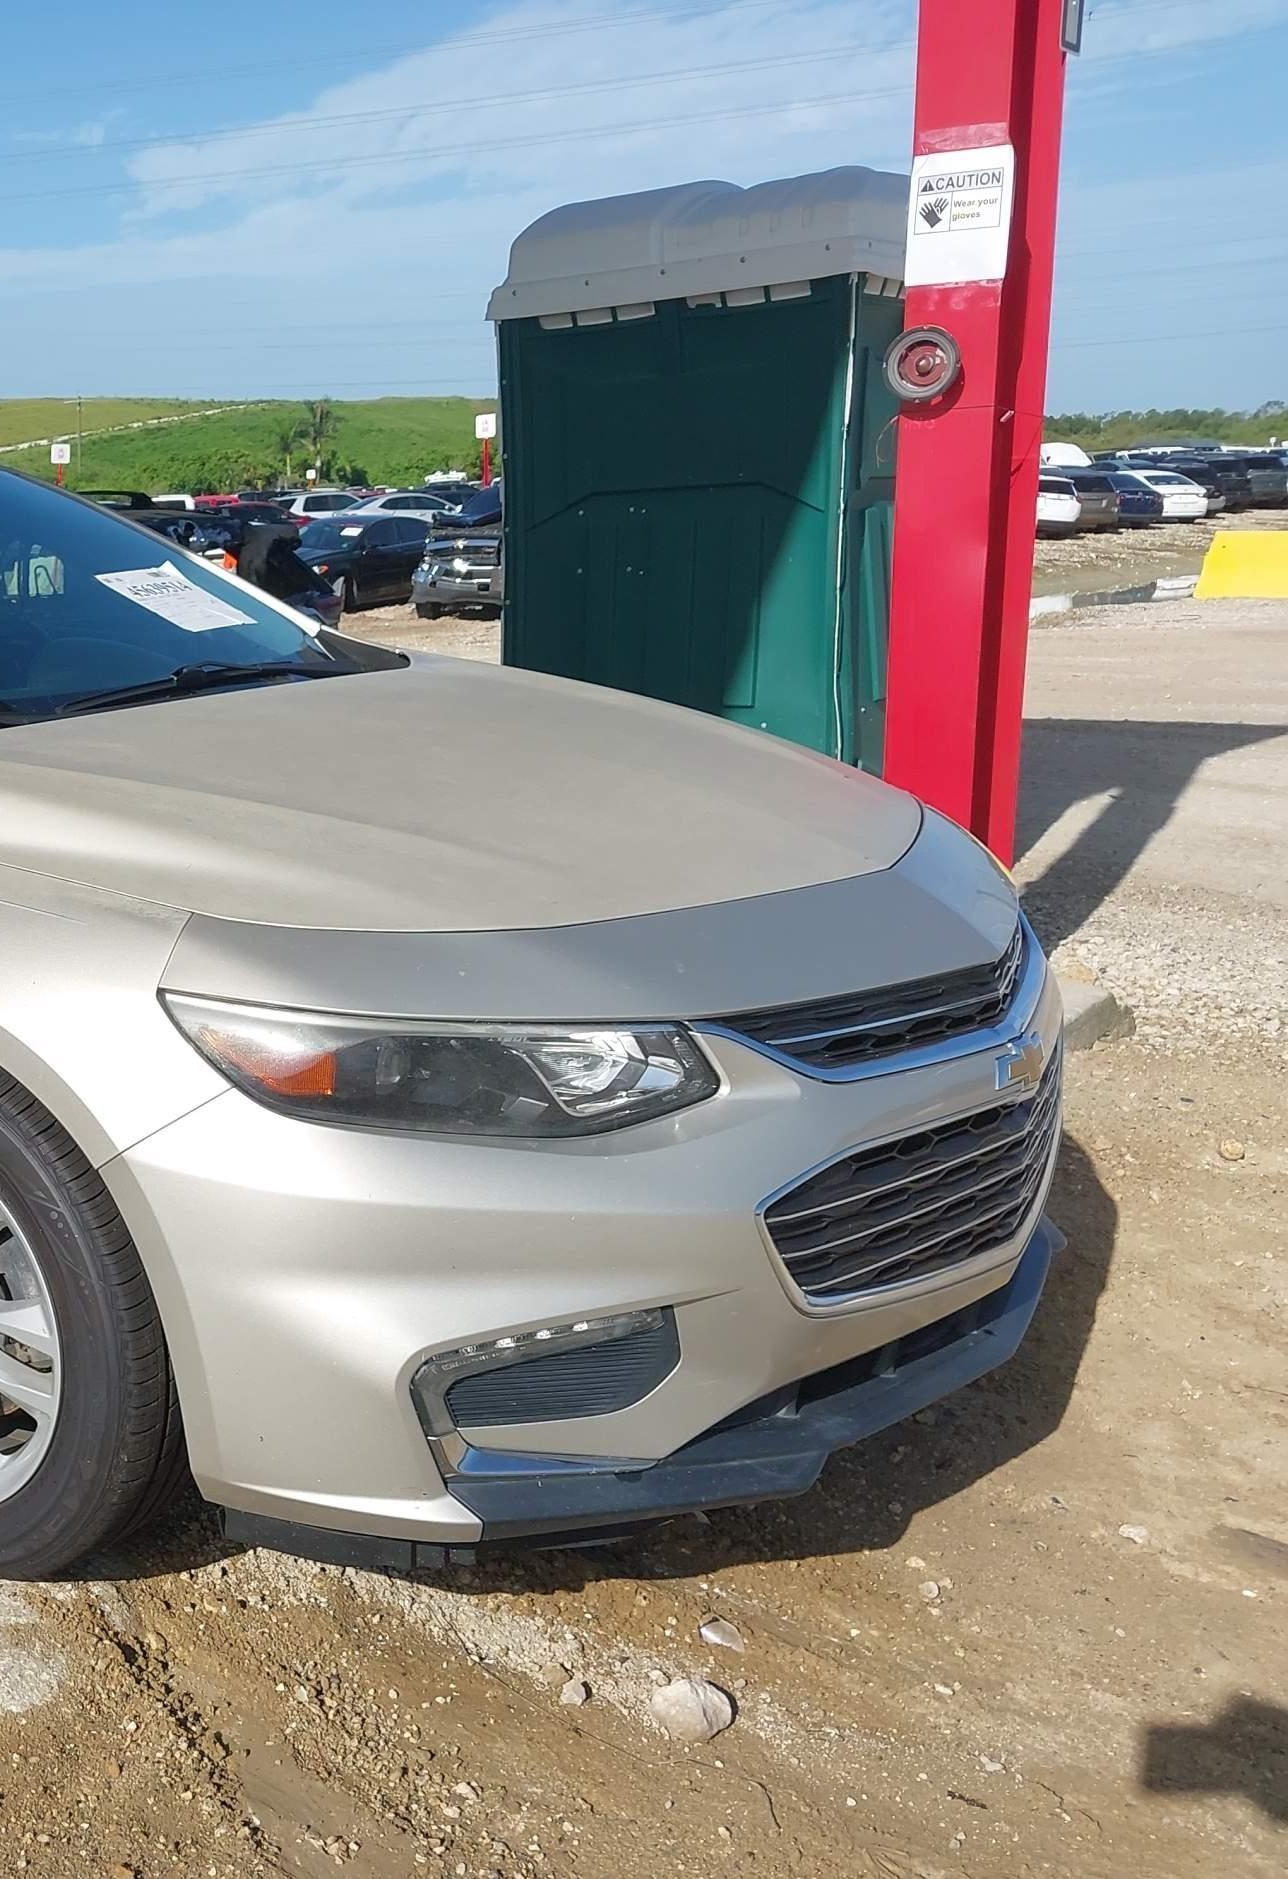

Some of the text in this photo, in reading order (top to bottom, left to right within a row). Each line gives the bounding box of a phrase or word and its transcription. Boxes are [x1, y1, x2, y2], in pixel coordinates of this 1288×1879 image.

[935, 171, 1002, 191] CAUTION
[953, 197, 999, 210] Wear your
[951, 211, 981, 222] gloves
